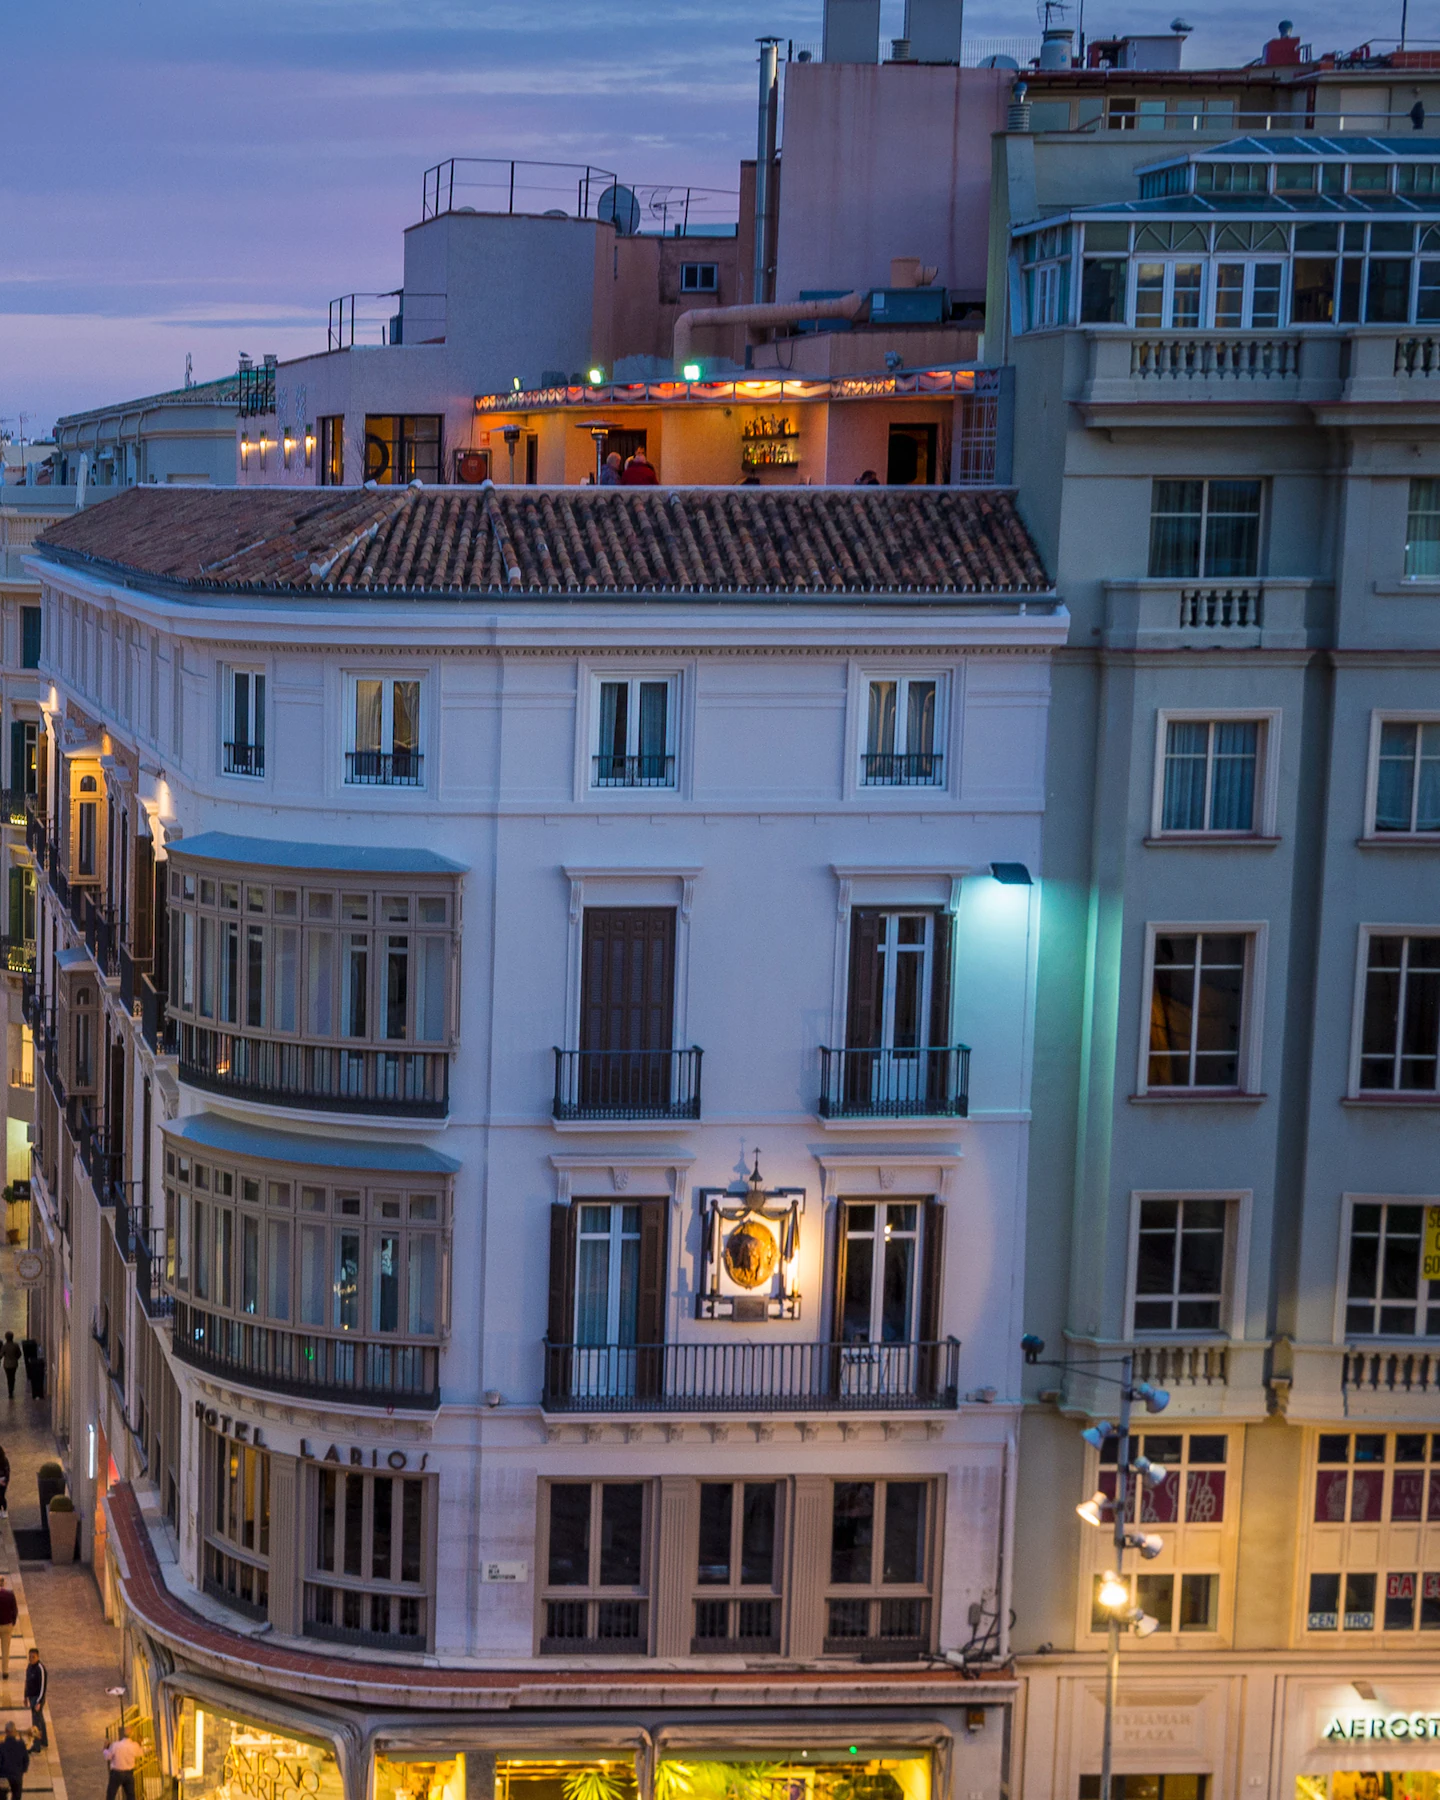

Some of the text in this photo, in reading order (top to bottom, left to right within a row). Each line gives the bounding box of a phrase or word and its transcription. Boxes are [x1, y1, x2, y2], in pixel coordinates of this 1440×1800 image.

[195, 1400, 429, 1471] HOTEL LARIOS
[1310, 1614, 1372, 1628] CENTRO
